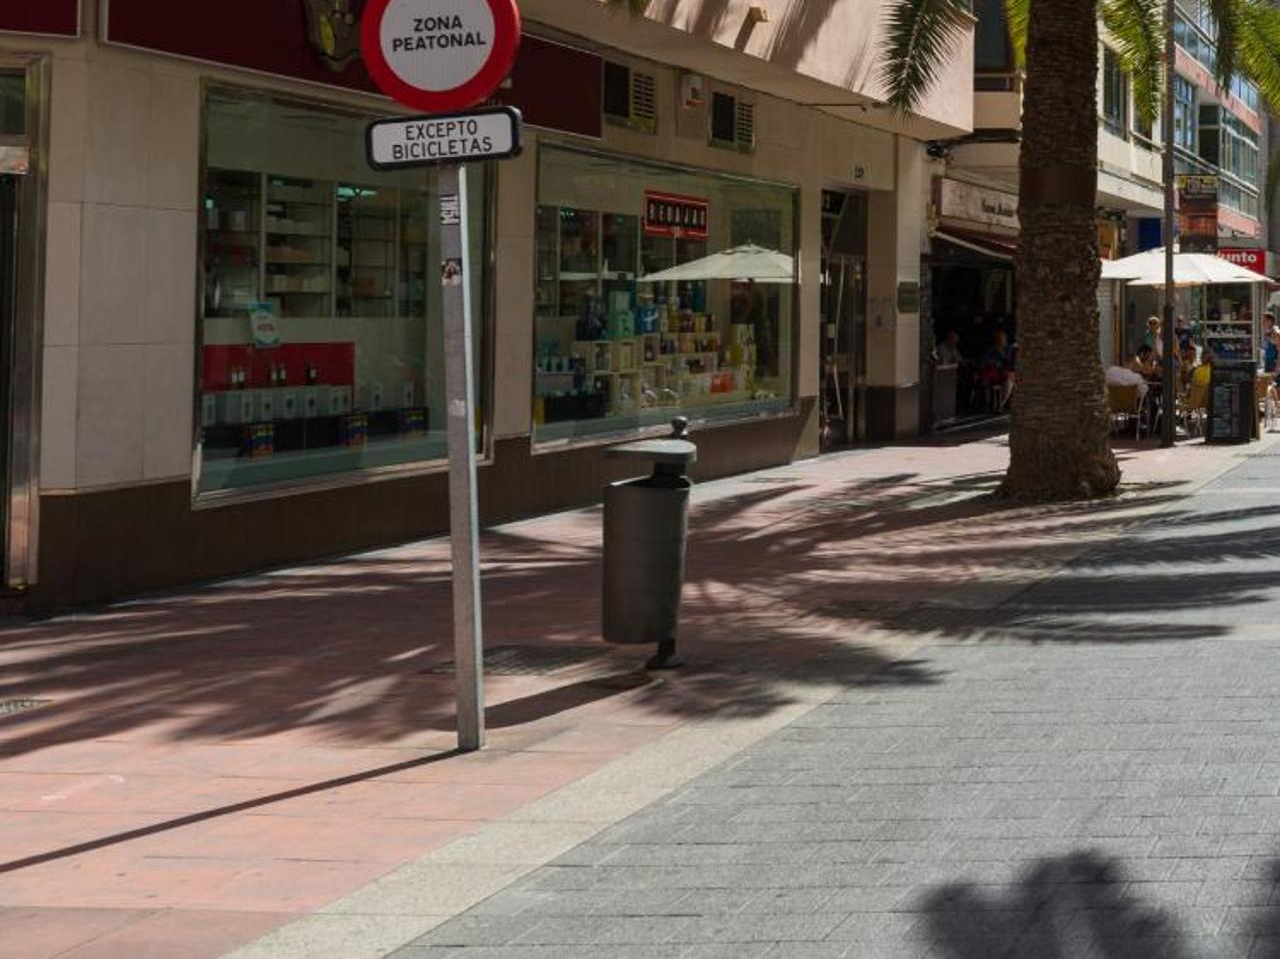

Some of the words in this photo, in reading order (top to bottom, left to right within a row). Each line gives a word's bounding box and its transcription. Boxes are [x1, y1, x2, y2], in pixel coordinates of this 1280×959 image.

[413, 14, 463, 33] ZONA
[392, 32, 487, 52] PEATONAL
[404, 120, 478, 141] EXCEPTO
[392, 137, 493, 160] BICICLETAS
